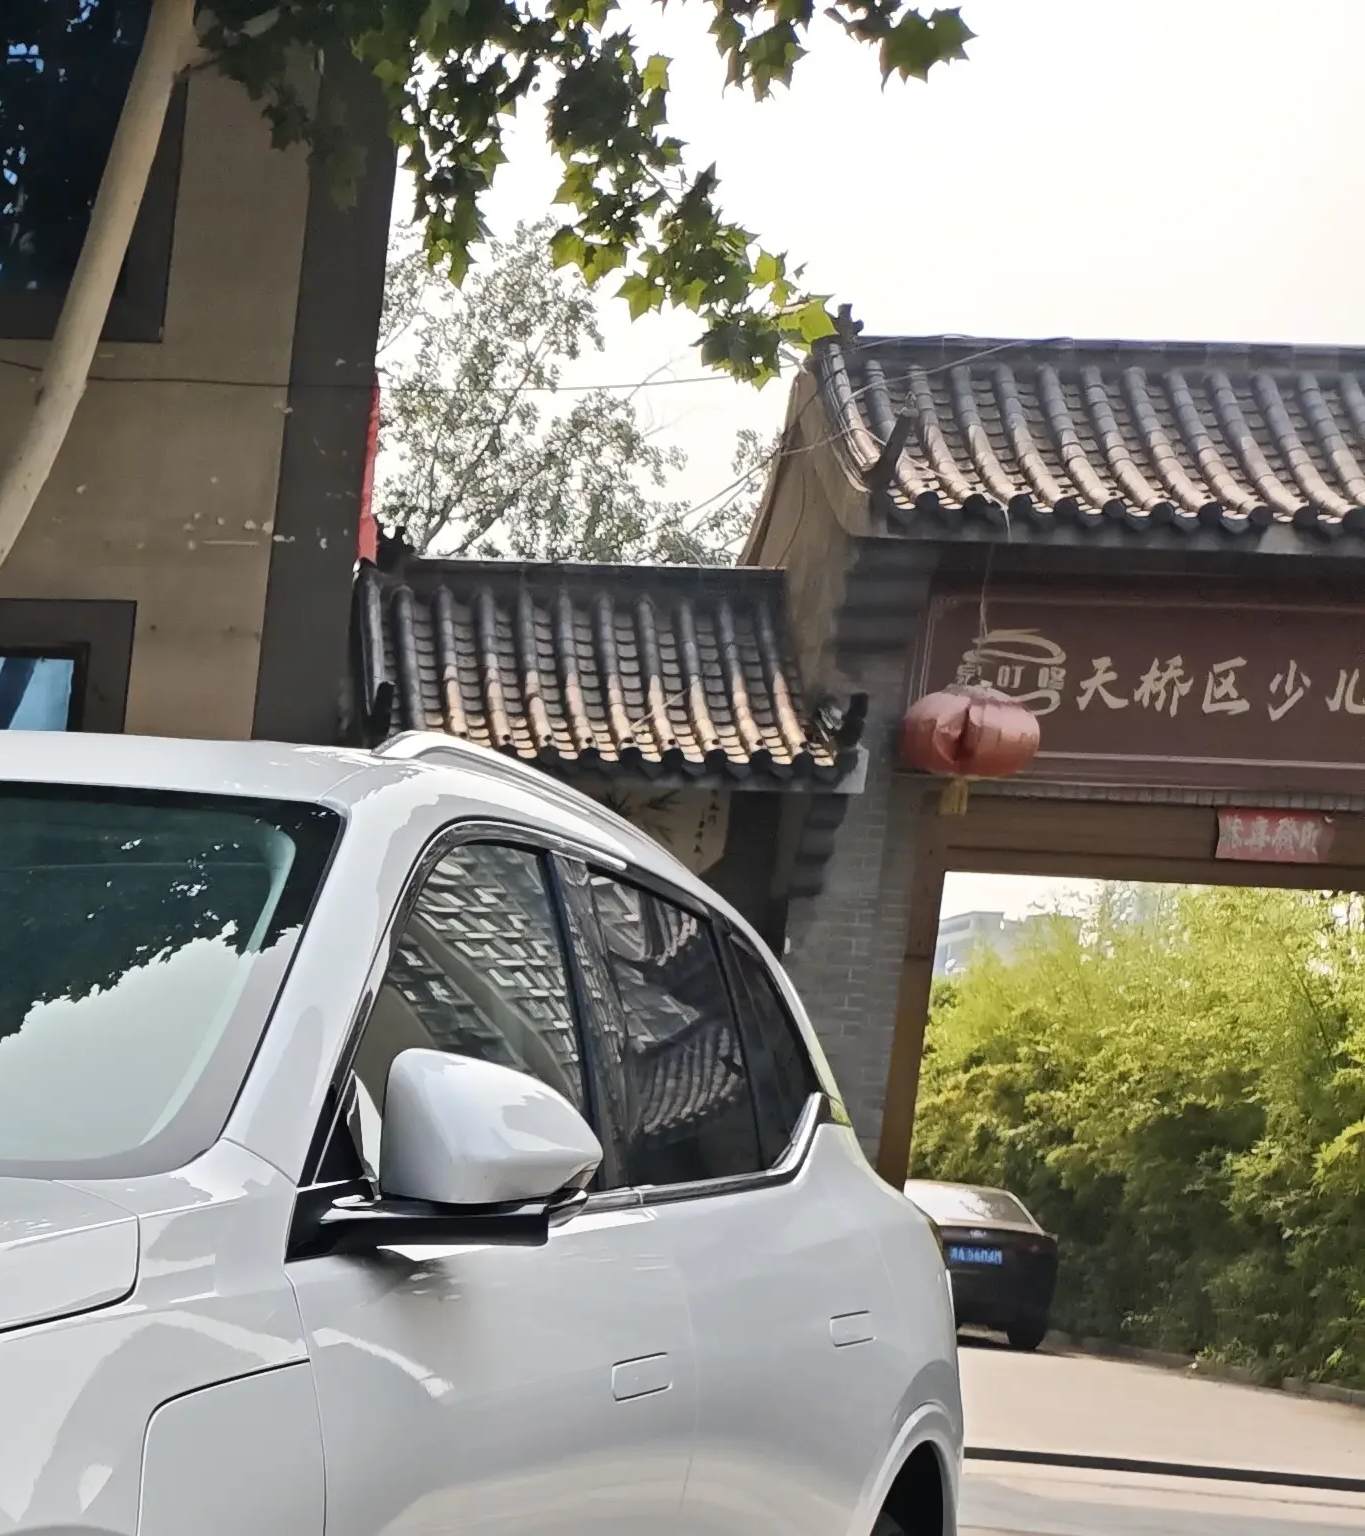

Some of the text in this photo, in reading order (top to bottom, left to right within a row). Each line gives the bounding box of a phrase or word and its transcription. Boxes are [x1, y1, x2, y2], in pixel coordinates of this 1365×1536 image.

[1076, 654, 1365, 721] 天桥区少儿
